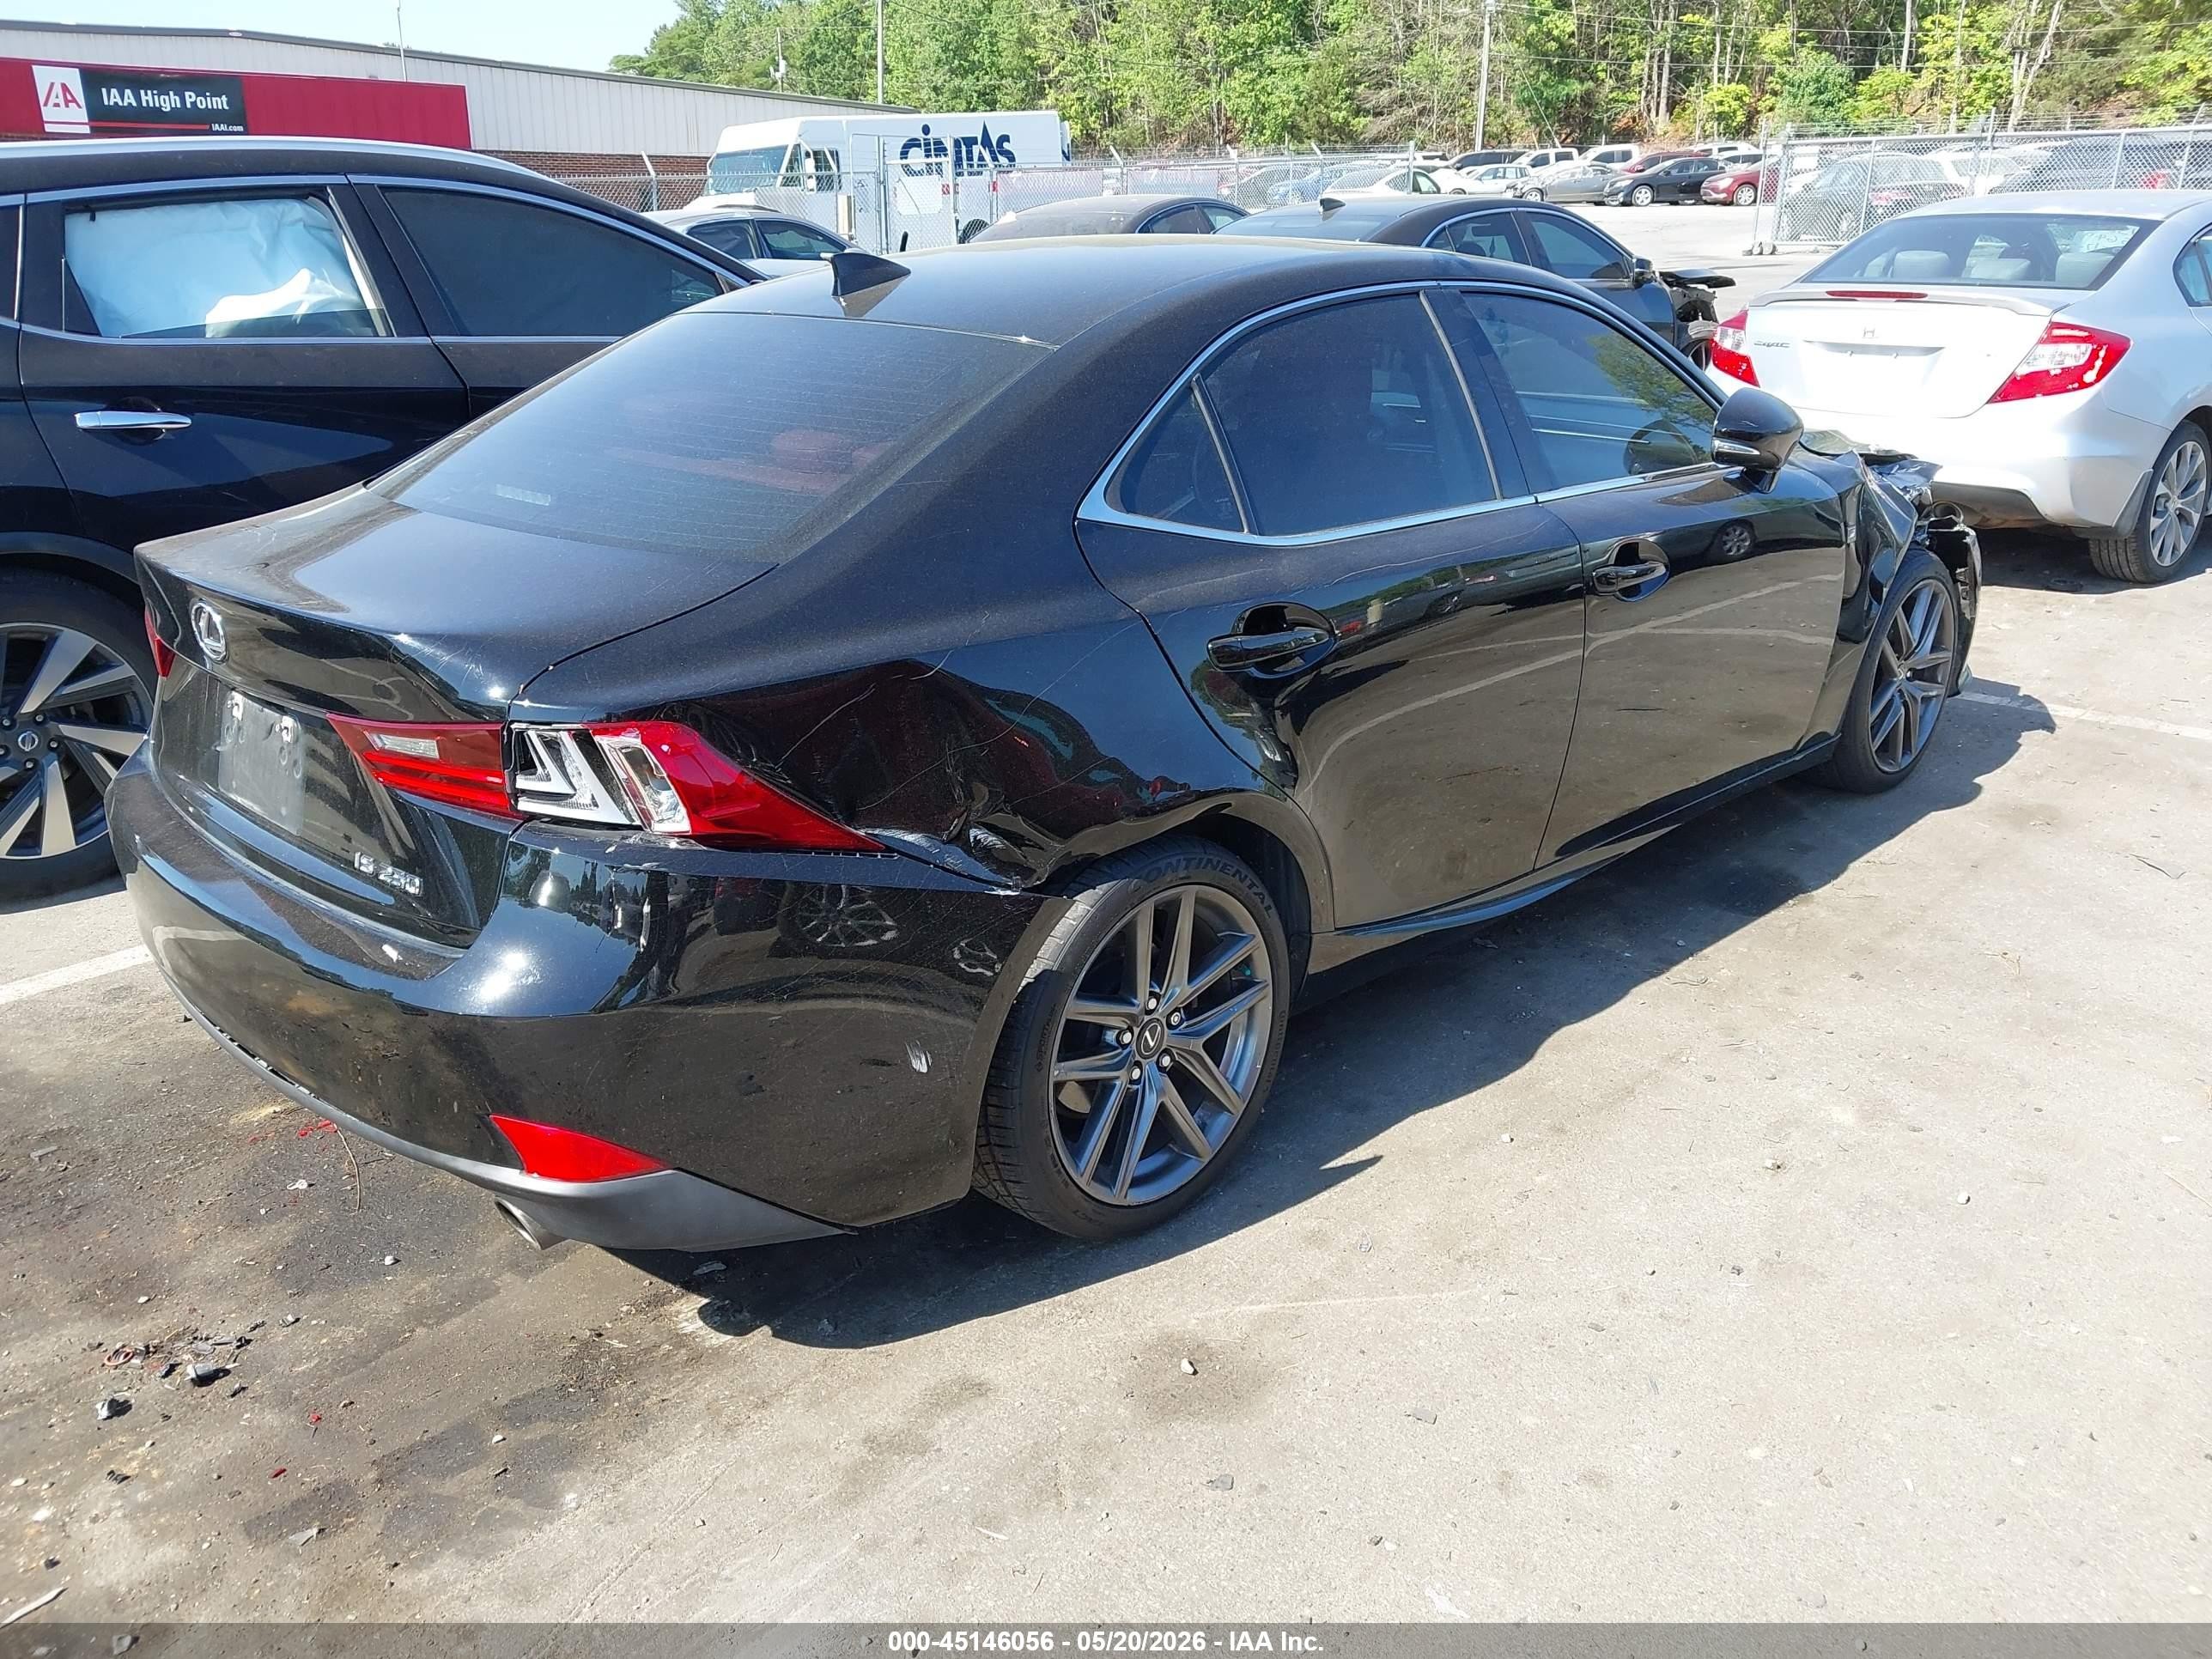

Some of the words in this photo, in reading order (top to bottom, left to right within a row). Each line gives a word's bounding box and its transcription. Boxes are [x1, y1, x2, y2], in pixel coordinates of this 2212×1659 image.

[101, 88, 137, 106] IAA
[140, 89, 181, 112] High
[185, 91, 229, 110] Point
[211, 123, 244, 132] IAAI.com
